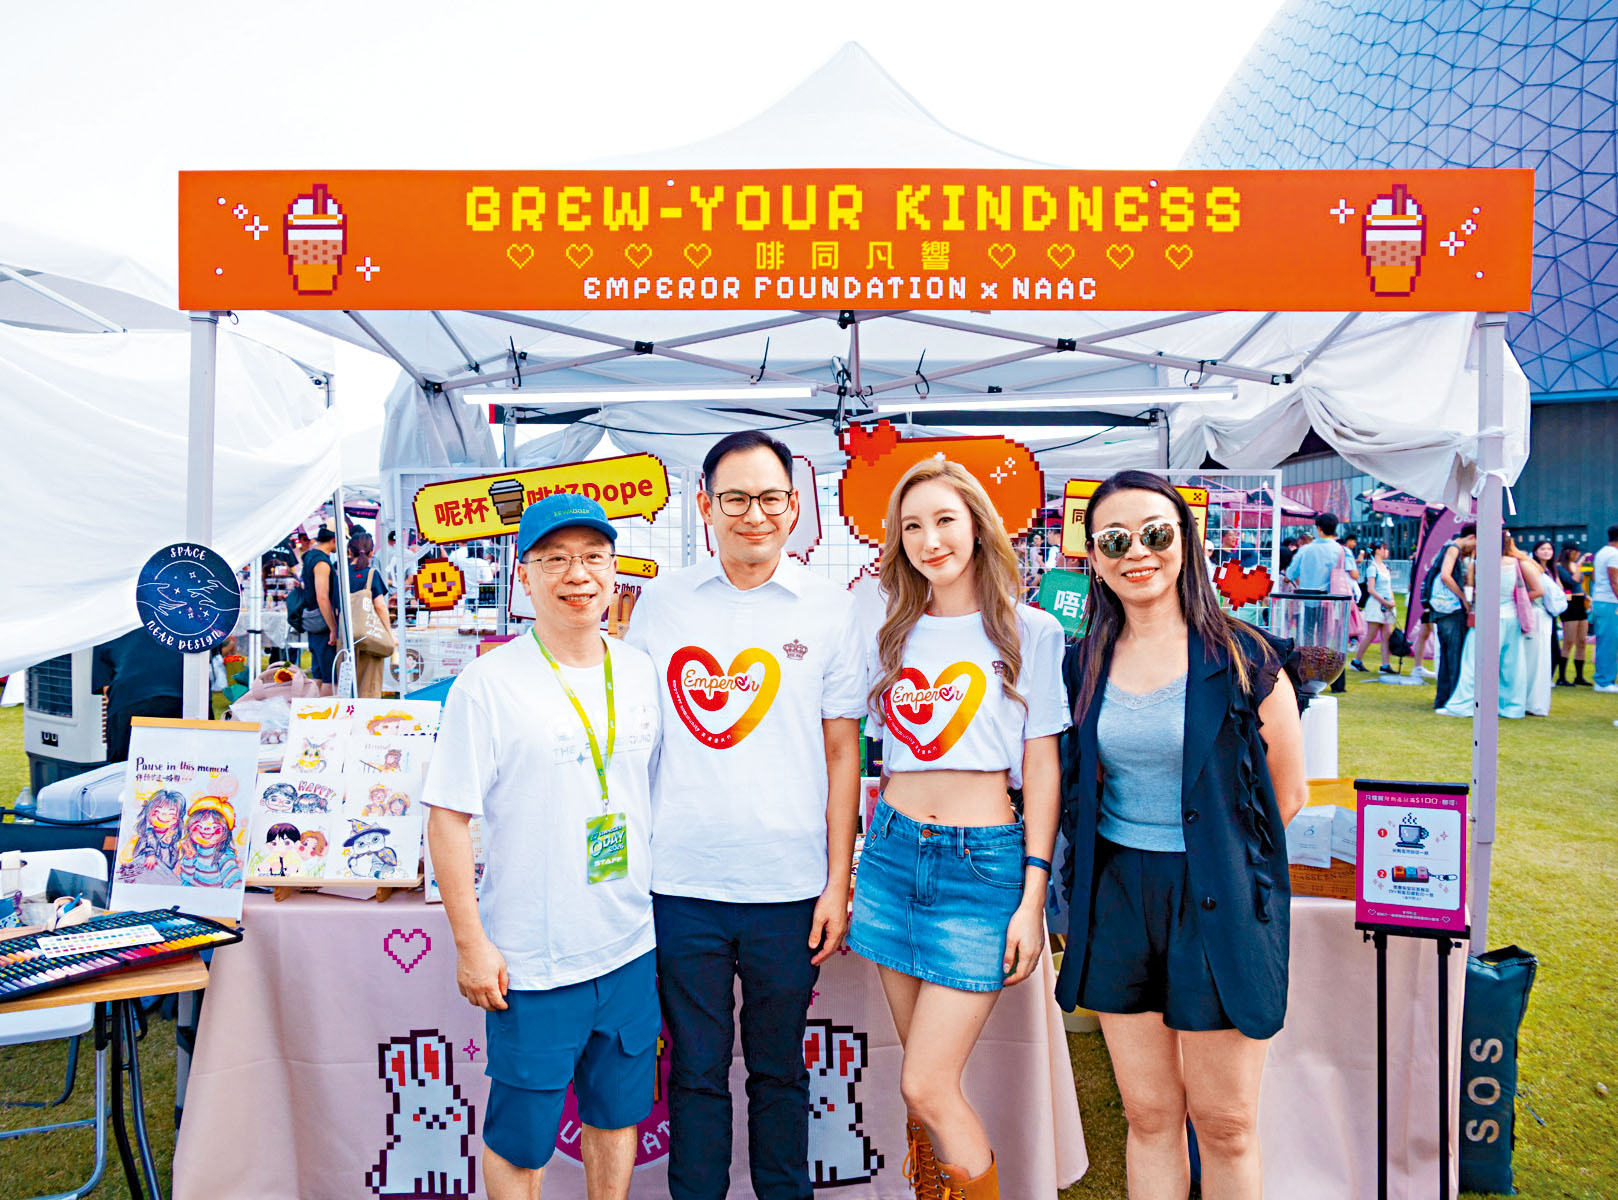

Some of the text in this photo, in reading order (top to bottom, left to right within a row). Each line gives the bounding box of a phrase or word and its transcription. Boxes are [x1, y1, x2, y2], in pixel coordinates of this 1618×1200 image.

[466, 185, 1240, 232] BREW-YOUR KINDNESS
[756, 240, 951, 271] 啡同凡響
[583, 276, 740, 299] EMPEROR
[755, 276, 966, 299] FOUNDATION
[1012, 277, 1097, 300] NAAC
[434, 496, 490, 527] 呢杯
[170, 545, 206, 560] SPACE
[146, 620, 221, 650] NEAR DESIGN
[136, 756, 230, 773] Pause in this moment
[593, 856, 622, 867] STAFF
[1465, 1037, 1504, 1144] SOS
